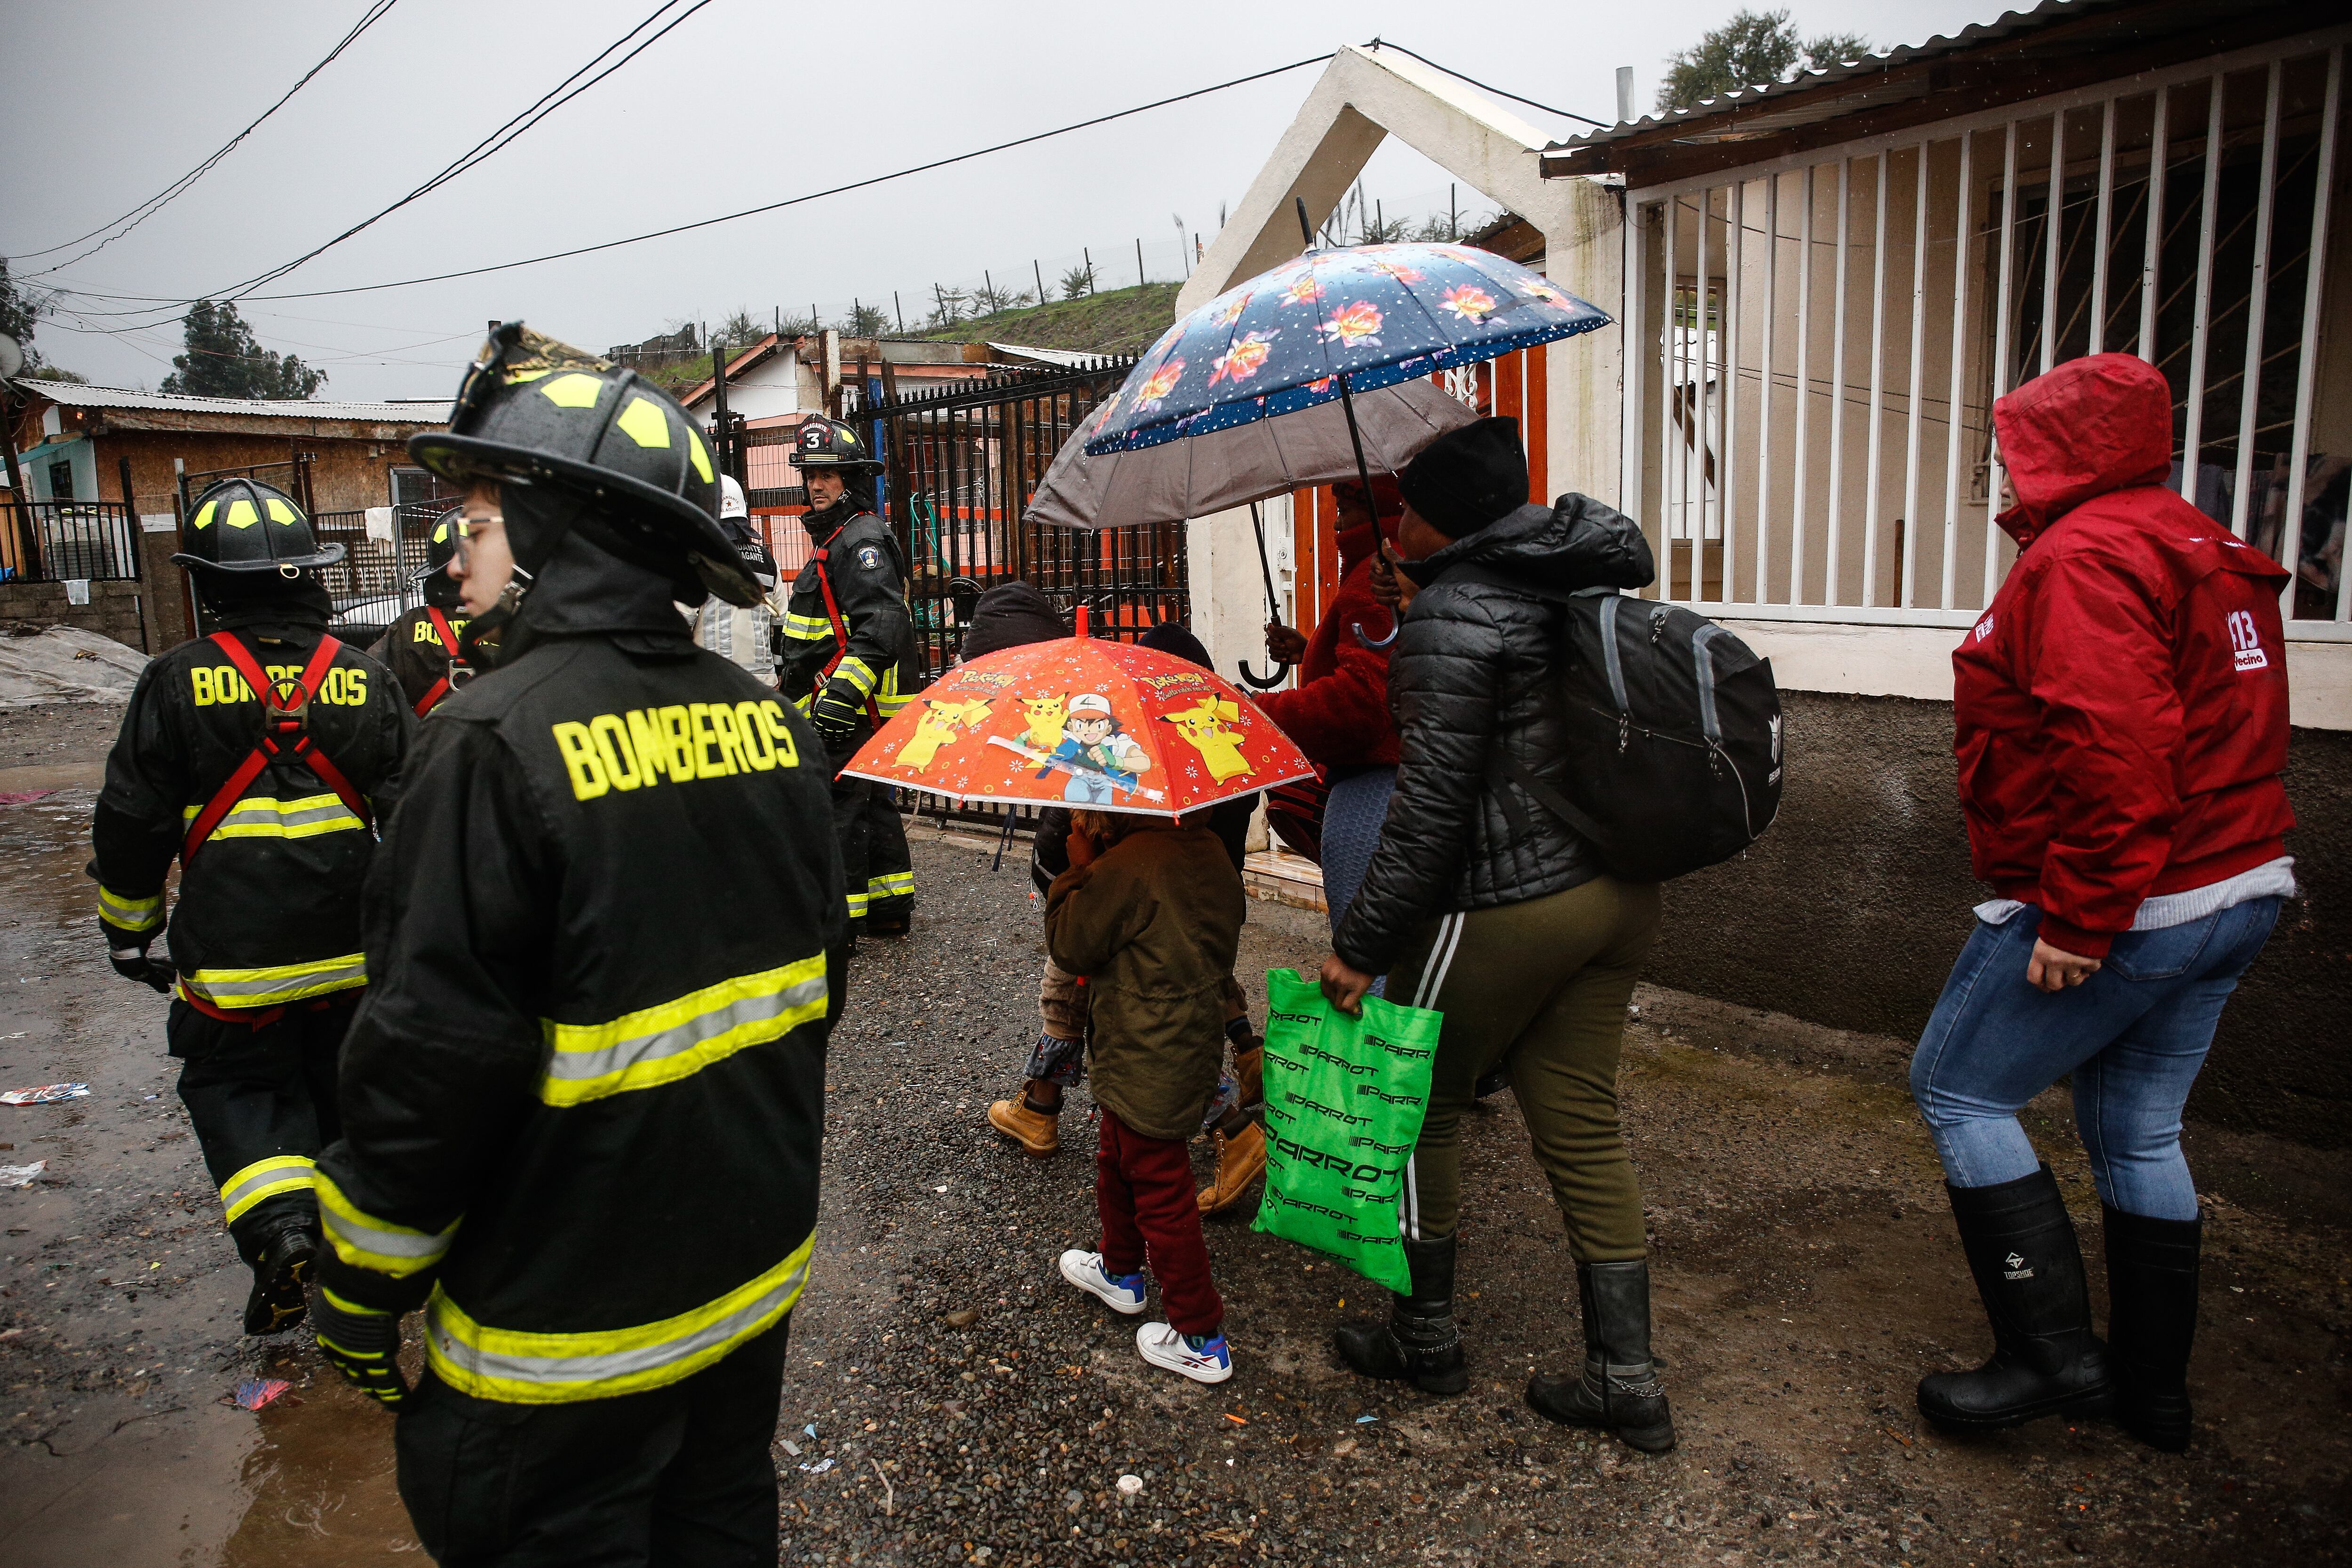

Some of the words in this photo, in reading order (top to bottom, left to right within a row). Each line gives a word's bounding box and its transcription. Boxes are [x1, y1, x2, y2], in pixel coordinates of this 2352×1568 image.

[801, 422, 827, 433] TALAGANTE
[806, 432, 820, 449] 3
[741, 551, 764, 564] AGANTE
[552, 700, 799, 801] BOMBEROS
[1373, 1036, 1431, 1059] PARR
[1305, 1045, 1378, 1076] PARROT
[1366, 1085, 1422, 1106] PARR
[1291, 1093, 1373, 1127] PARROT
[1275, 1188, 1358, 1224] PARROT
[2003, 1268, 2034, 1279] TOPSHOE
